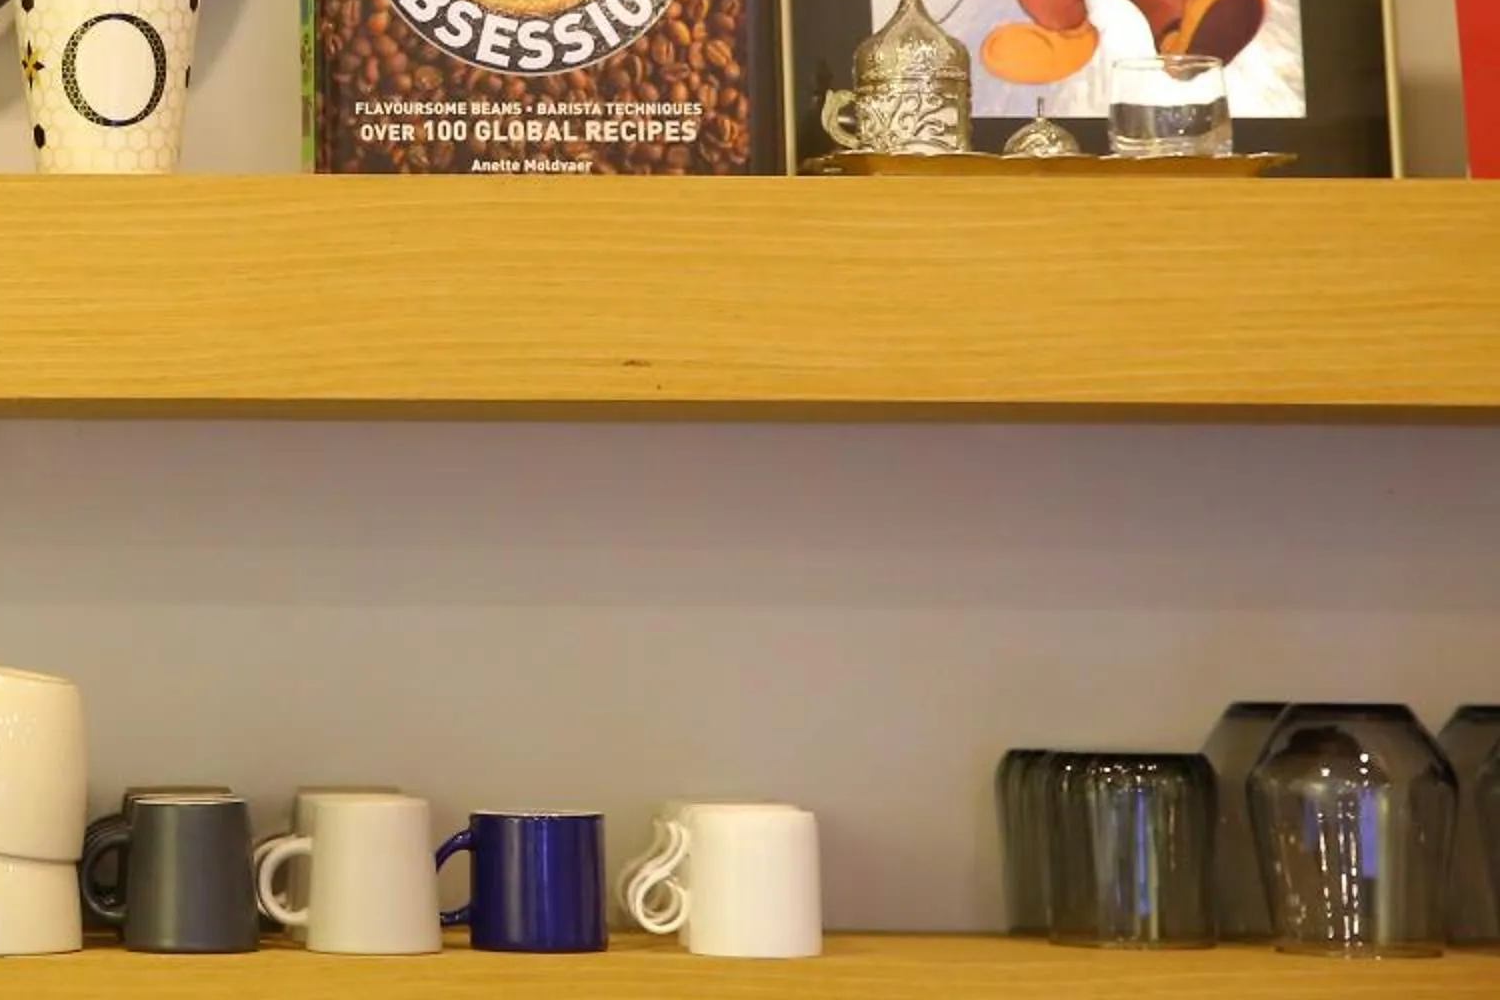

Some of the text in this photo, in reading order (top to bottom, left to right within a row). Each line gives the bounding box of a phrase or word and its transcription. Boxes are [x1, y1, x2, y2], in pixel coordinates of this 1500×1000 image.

[355, 102, 703, 115] FLAVOURSOME BEANS BARISTA TECHNIQUES
[360, 120, 697, 142] OVER 100 GLOBAL RECIPES
[472, 159, 593, 172] Anette Moldvaer
